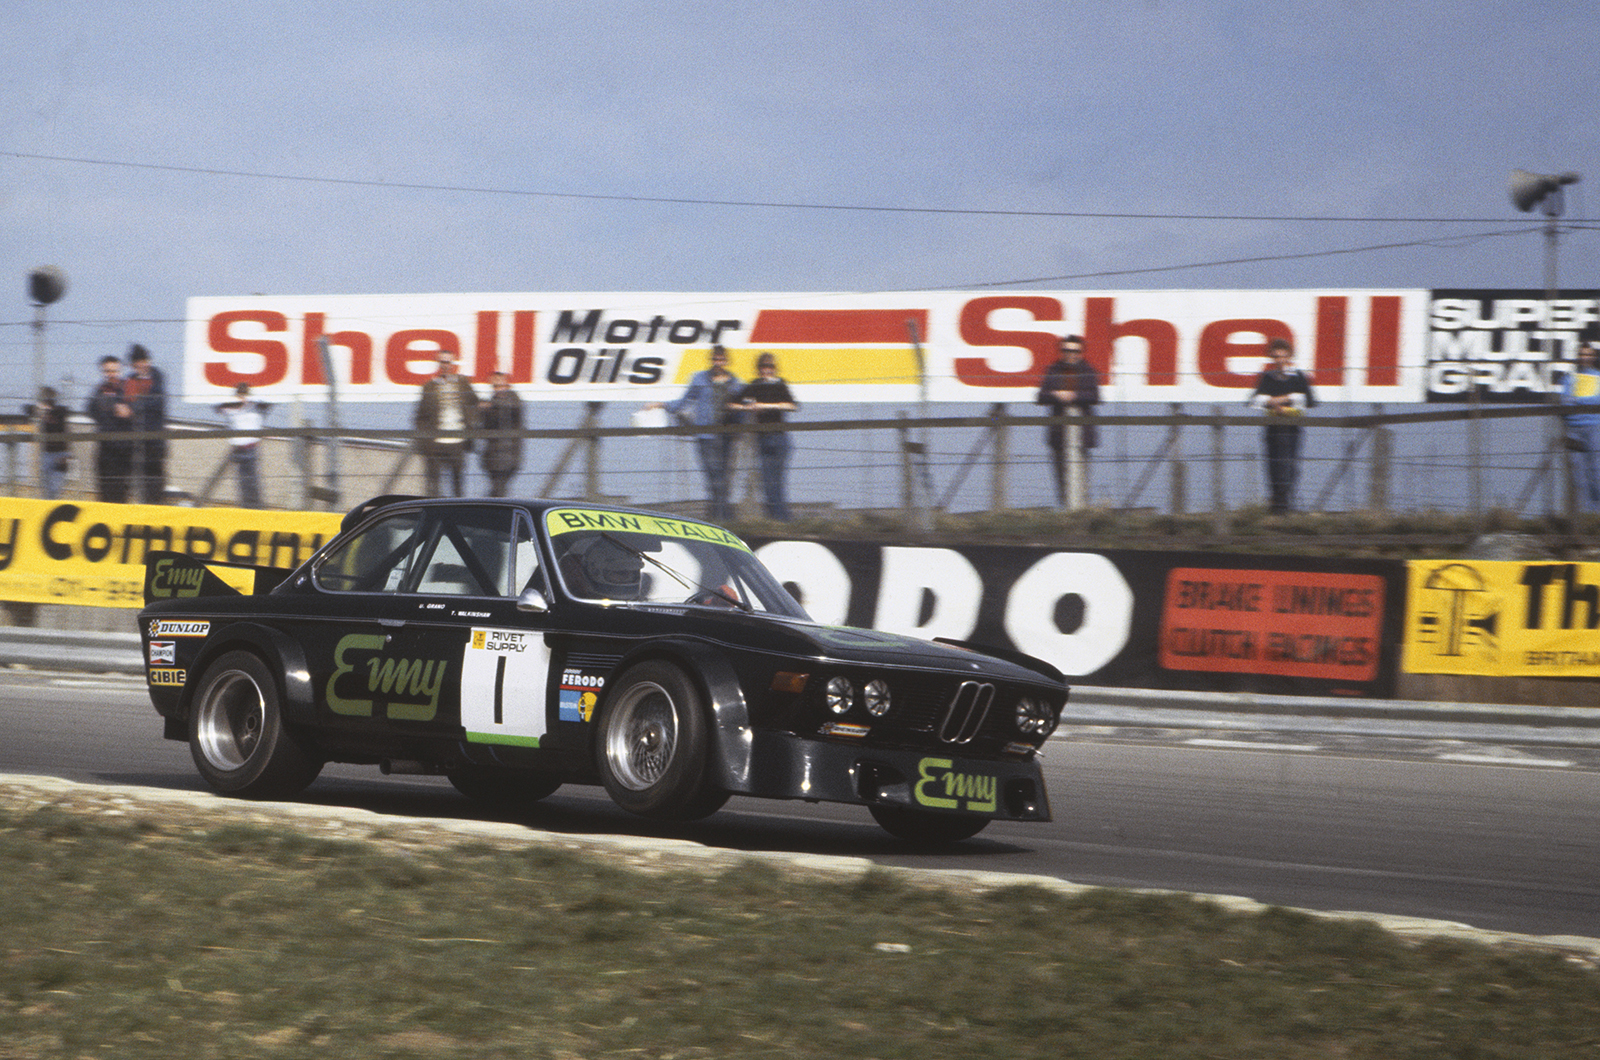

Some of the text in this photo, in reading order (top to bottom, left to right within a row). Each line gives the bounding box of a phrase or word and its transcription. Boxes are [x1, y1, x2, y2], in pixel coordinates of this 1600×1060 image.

[549, 309, 741, 344] Motor
[954, 295, 1404, 388] Shell
[204, 309, 536, 388] Shell
[547, 348, 666, 384] Oils
[1429, 361, 1580, 394] GRAD
[41, 503, 325, 568] Compan
[558, 512, 744, 547] BMW ITALIA
[160, 623, 209, 634] DUNLOP
[492, 631, 525, 643] RIVET
[486, 641, 528, 653] SUPPLY
[493, 655, 507, 725] 1
[562, 674, 604, 687] FERODO
